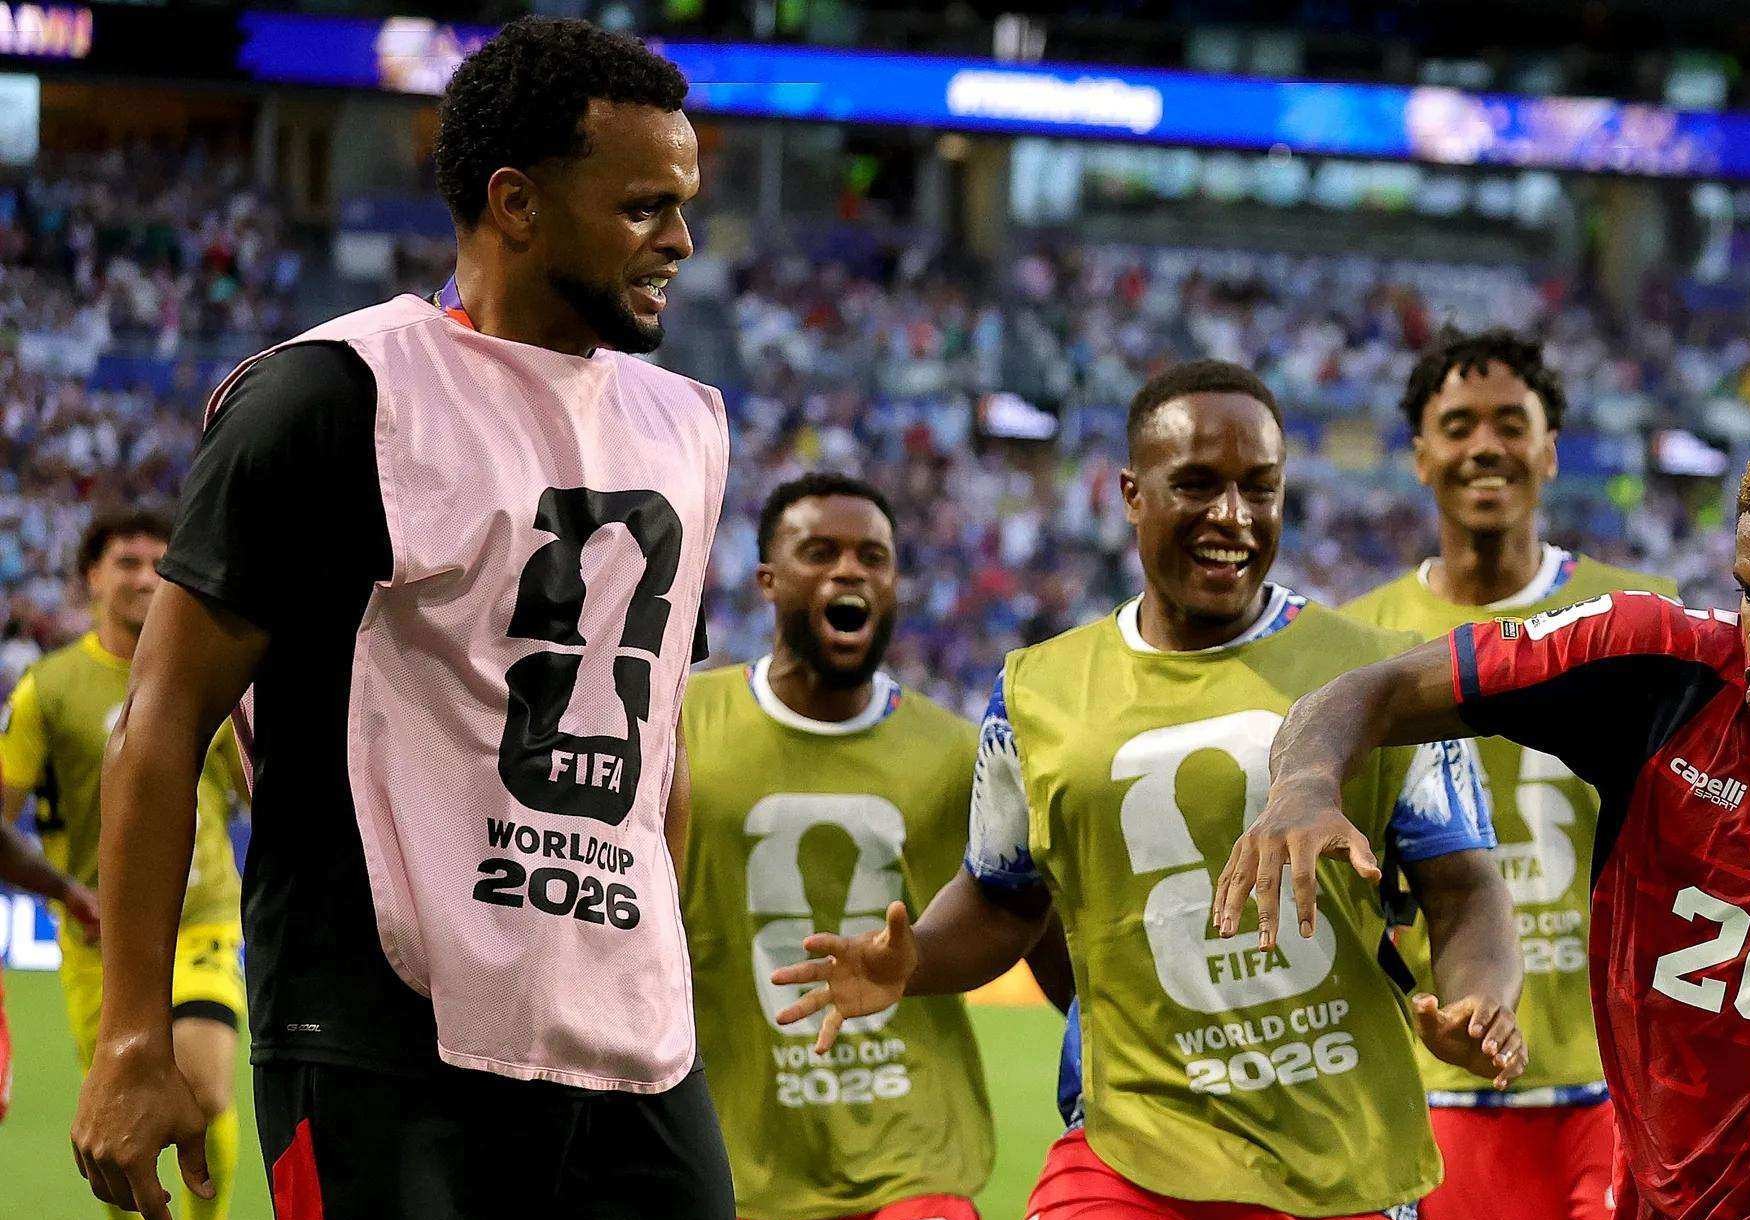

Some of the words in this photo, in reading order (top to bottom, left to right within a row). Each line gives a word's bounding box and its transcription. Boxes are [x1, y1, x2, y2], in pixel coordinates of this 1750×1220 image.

[548, 750, 623, 795] FIFA
[1670, 757, 1748, 806] capelli
[1694, 788, 1738, 812] SPORT
[486, 817, 599, 866] WORLD
[598, 839, 635, 876] CUP
[472, 857, 641, 930] 2026
[1206, 944, 1292, 984] FIFA
[1520, 937, 1588, 974] 26
[1174, 1014, 1286, 1056] WORLD
[1290, 998, 1350, 1034] CUP
[1185, 1030, 1360, 1096] 2026
